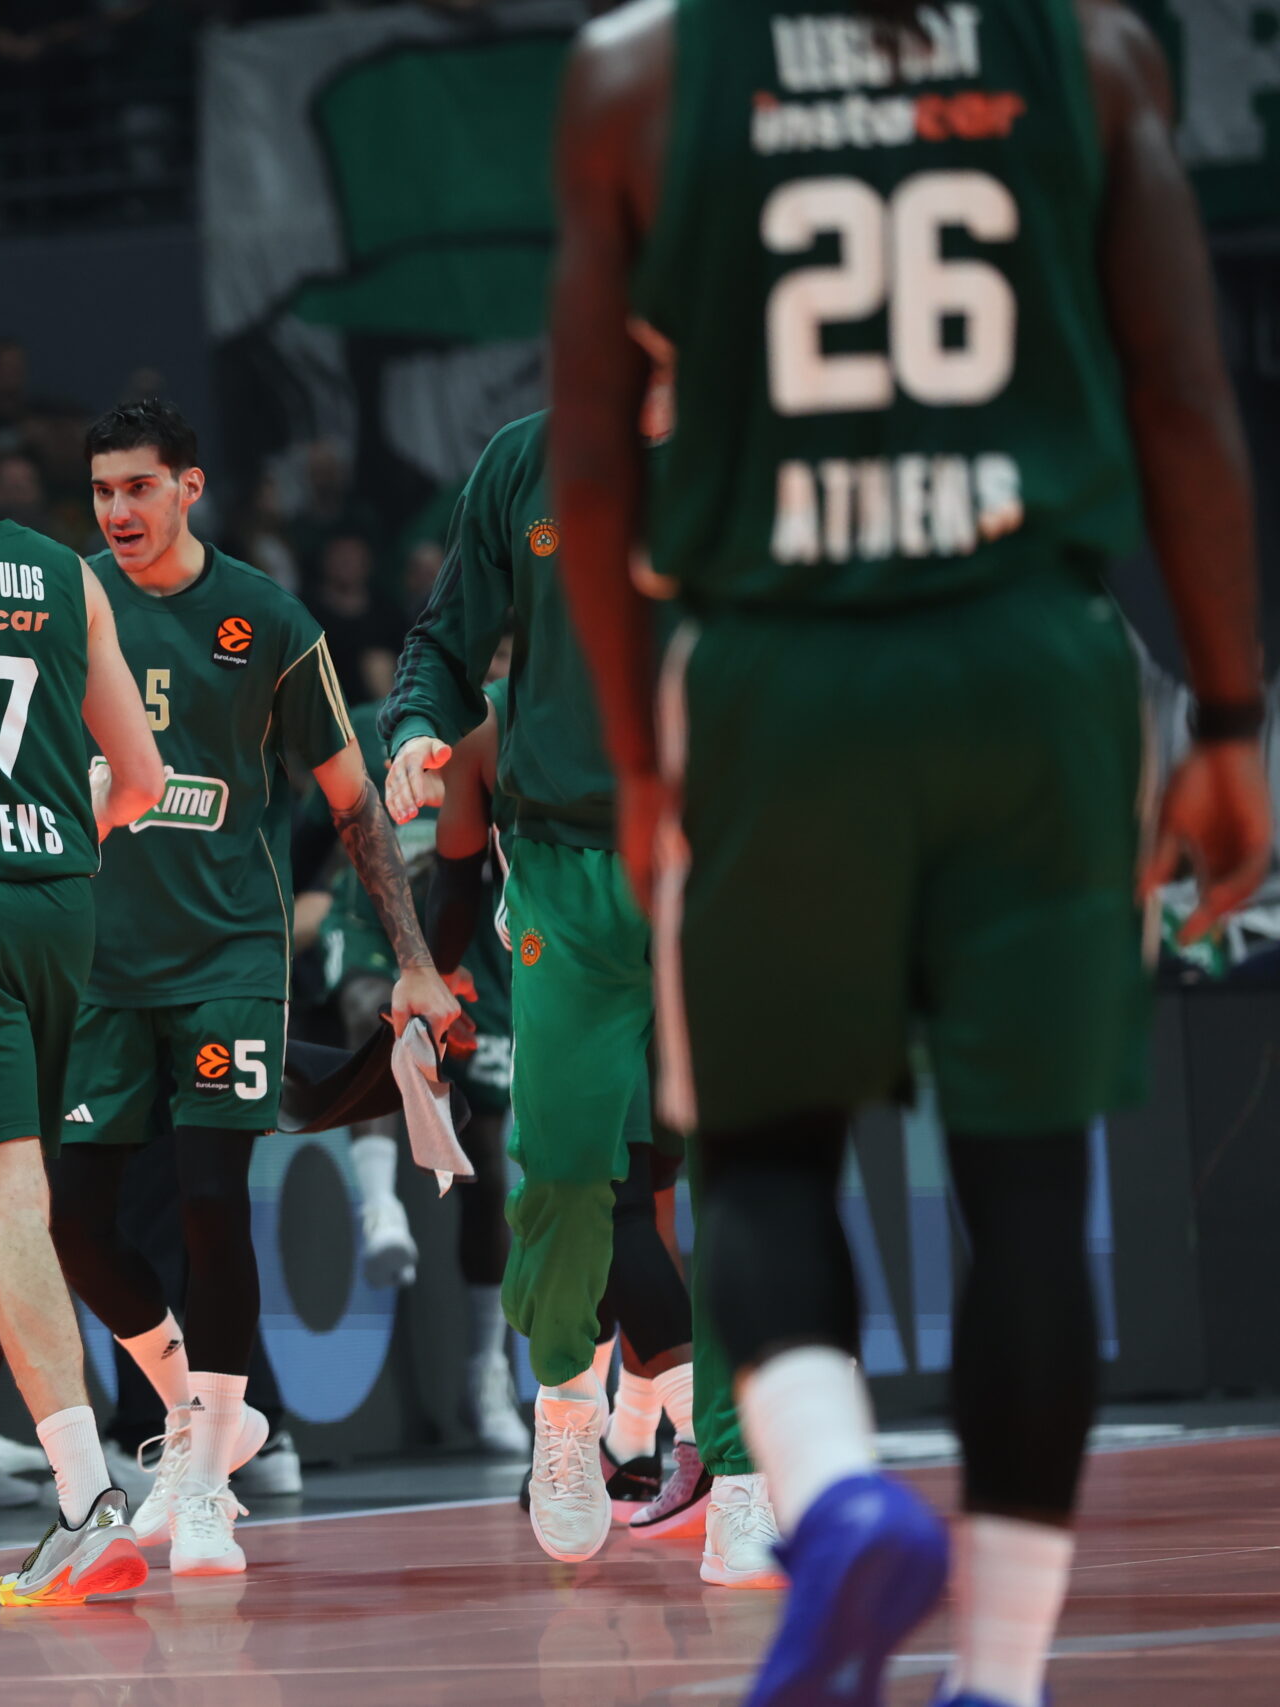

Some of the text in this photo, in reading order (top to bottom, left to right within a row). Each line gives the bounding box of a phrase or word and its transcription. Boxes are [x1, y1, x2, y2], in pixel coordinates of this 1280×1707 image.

[762, 171, 1018, 415] 26
[771, 453, 1024, 565] ATHENS
[213, 653, 247, 664] EuroLeague
[145, 669, 170, 731] 5
[234, 1039, 267, 1100] 5
